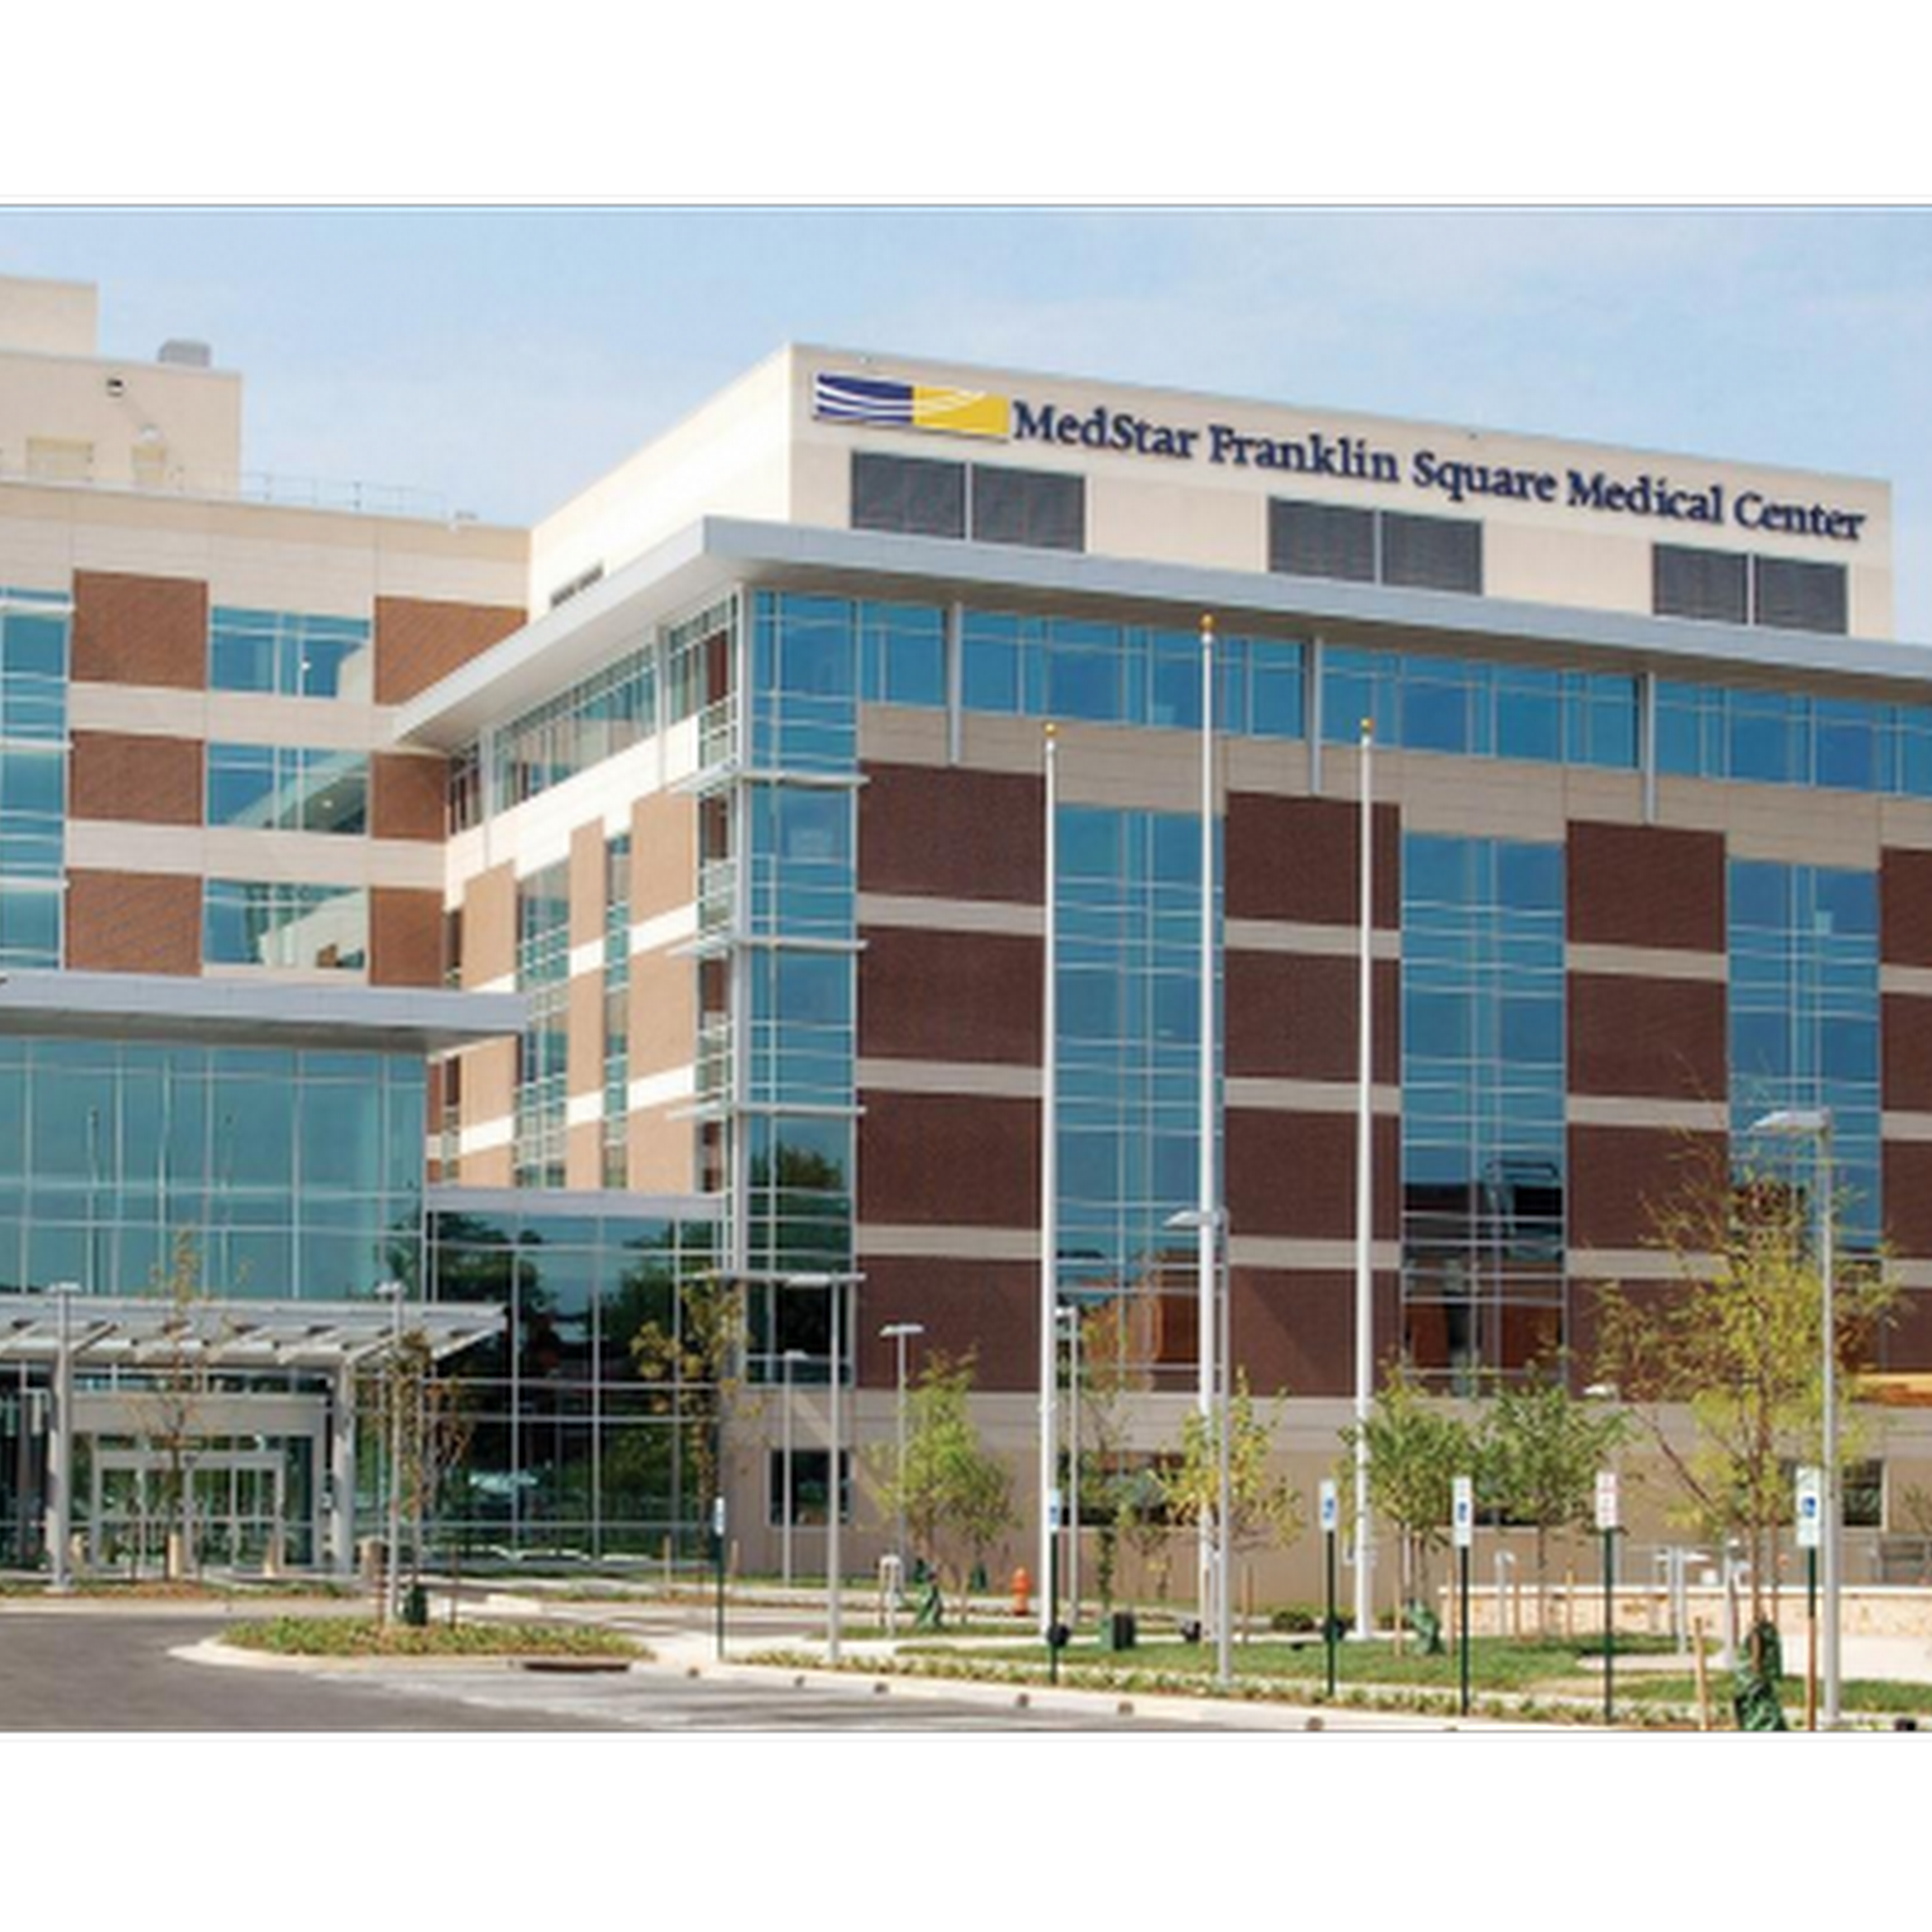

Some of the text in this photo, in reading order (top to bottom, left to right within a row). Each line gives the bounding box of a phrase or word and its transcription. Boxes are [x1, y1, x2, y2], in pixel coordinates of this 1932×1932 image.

[1012, 400, 1866, 542] MedStar Franklin Square Medical Center
